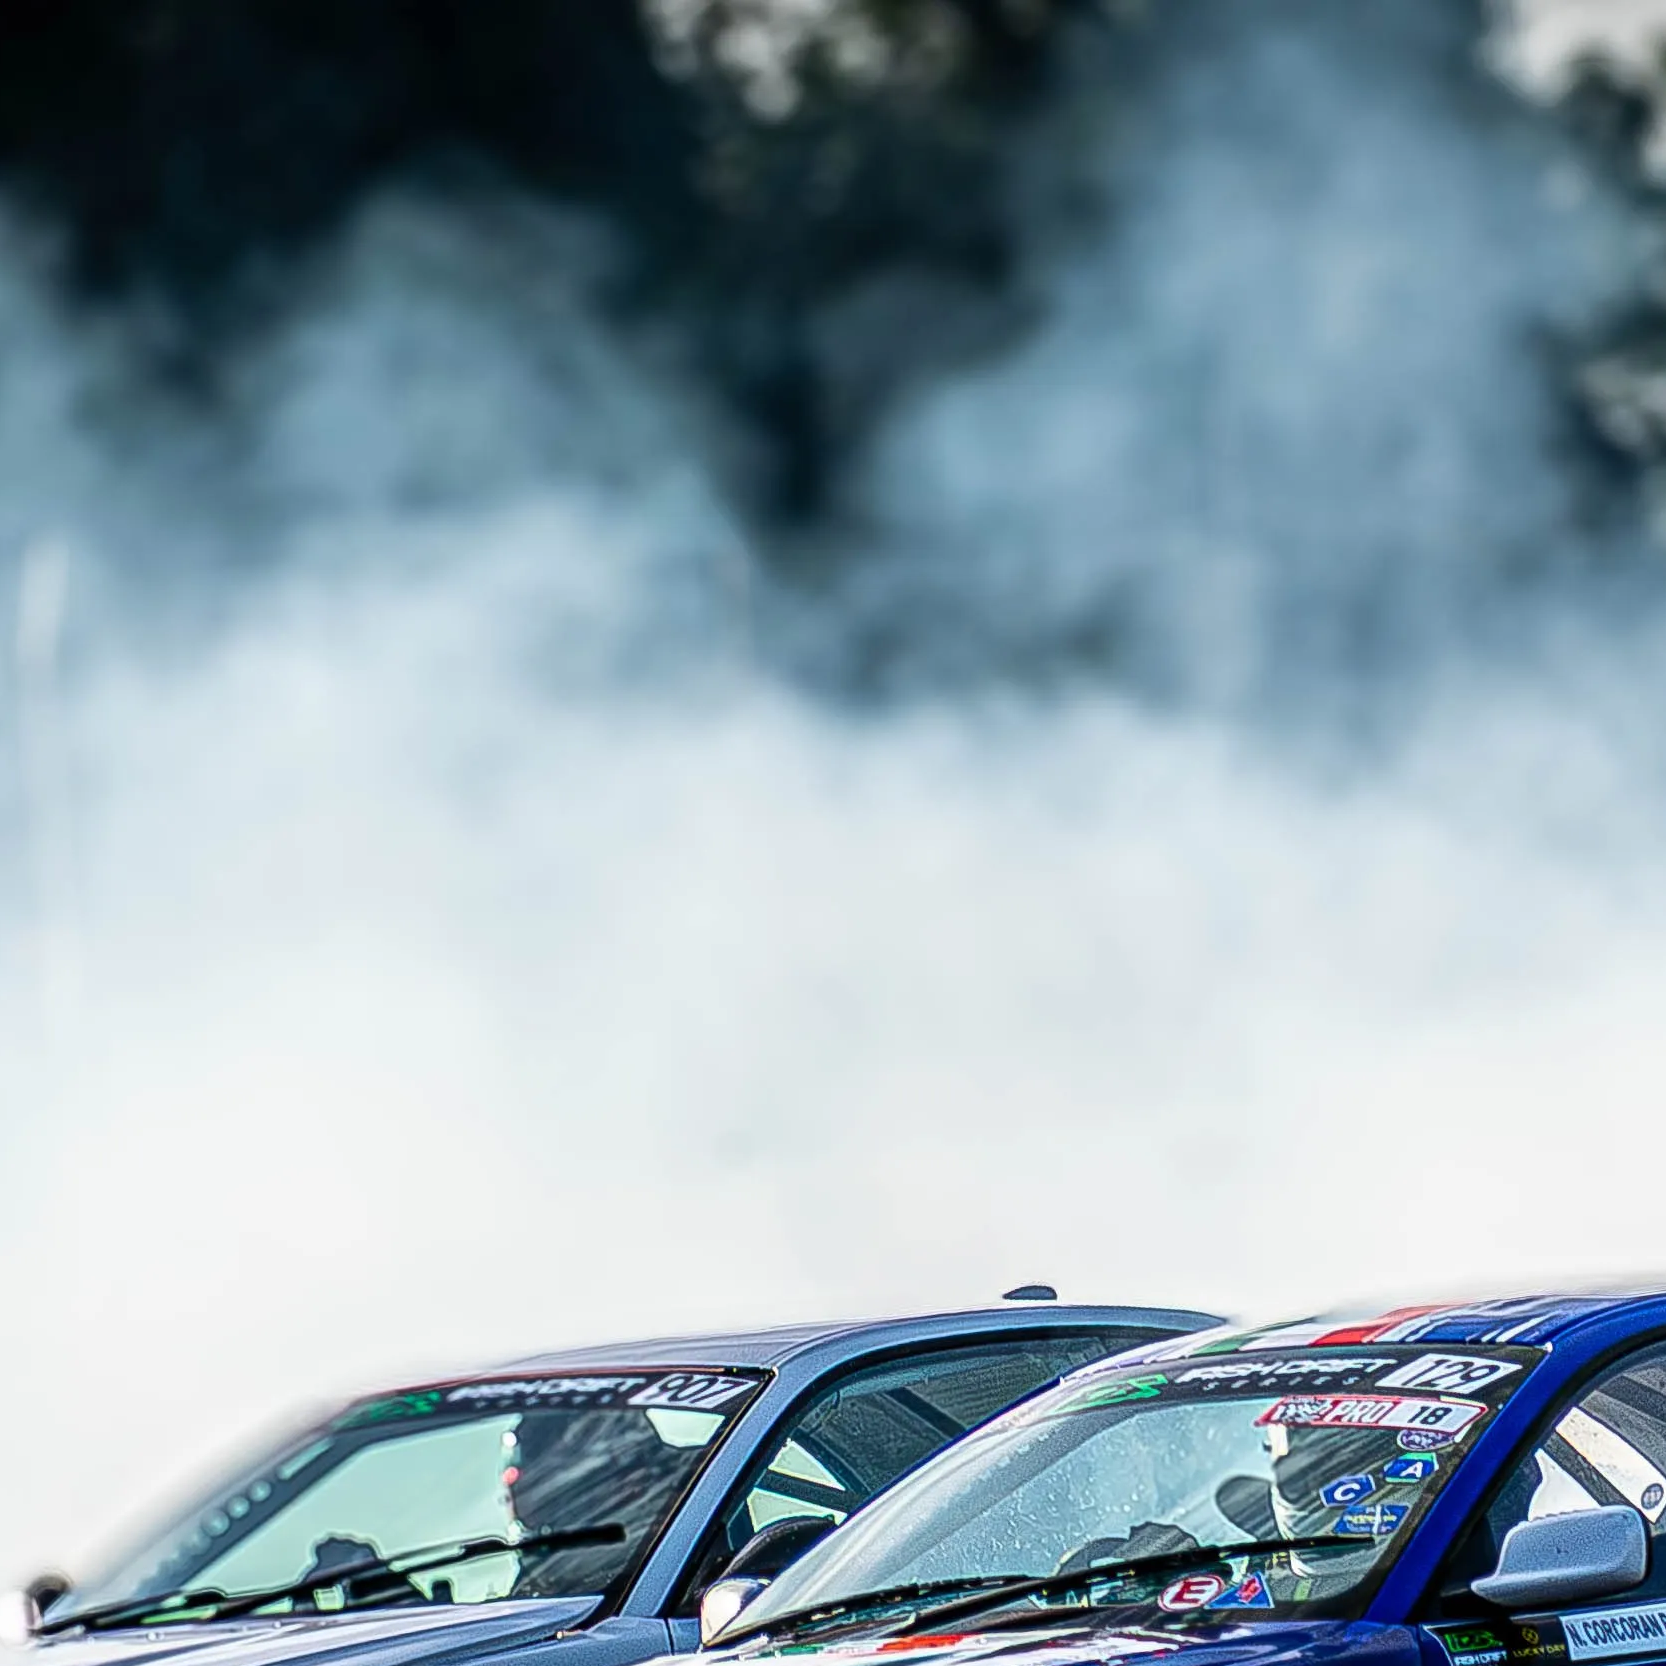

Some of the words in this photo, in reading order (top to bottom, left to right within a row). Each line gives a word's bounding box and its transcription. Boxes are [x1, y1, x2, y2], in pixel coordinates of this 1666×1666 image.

[1407, 1357, 1490, 1390] 129
[657, 1374, 747, 1404] 907
[1326, 1399, 1394, 1423] PRO
[1408, 1406, 1453, 1425] 18
[1400, 1461, 1423, 1478] A
[1333, 1483, 1361, 1501] C
[1585, 1613, 1663, 1647] CORCORAN
